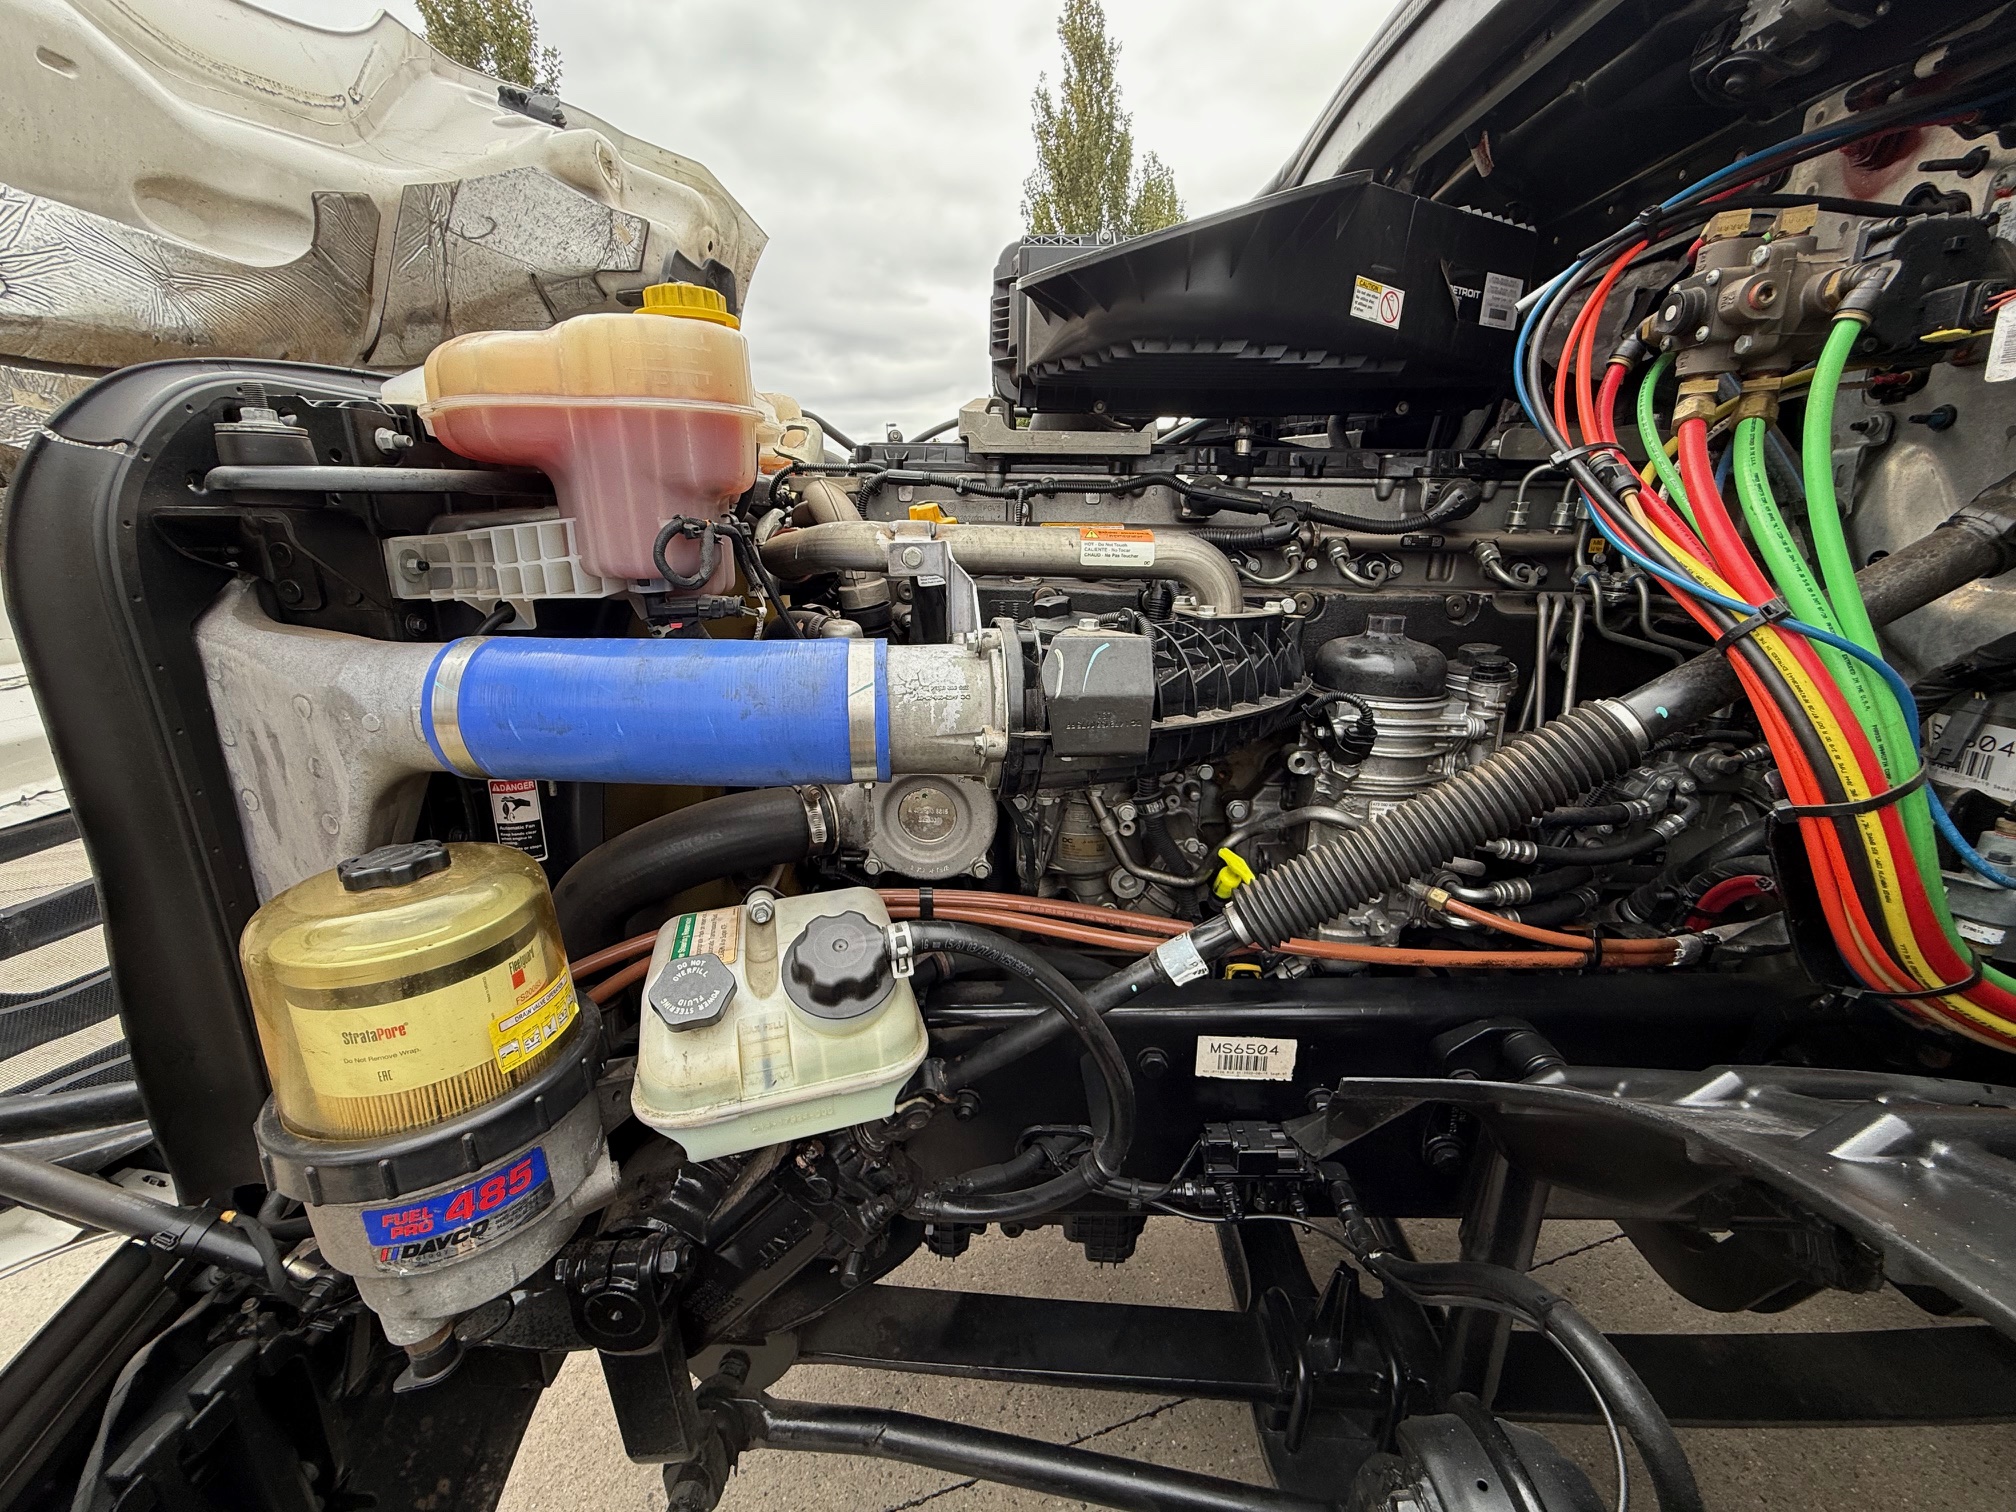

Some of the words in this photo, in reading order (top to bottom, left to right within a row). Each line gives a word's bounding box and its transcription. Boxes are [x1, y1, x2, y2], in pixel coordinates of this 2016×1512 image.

[1359, 278, 1380, 292] CAUTION
[1769, 650, 1789, 673] EXTRUDED
[1839, 651, 1857, 676] EXTRUDED
[500, 781, 535, 792] DANGER
[921, 939, 929, 950] 16
[966, 942, 1000, 961] 03/27/20
[672, 966, 709, 982] OVERFILL
[676, 961, 688, 971] DO
[660, 998, 695, 1015] STEERING
[677, 995, 705, 1006] FLUID
[698, 989, 721, 1011] POWER
[514, 1007, 532, 1023] DRAIN
[531, 998, 547, 1012] VALVE
[341, 1024, 407, 1046] StrataPore
[367, 1053, 398, 1062] Remove
[1210, 1042, 1279, 1056] MS6504
[377, 1069, 393, 1082] EAC
[382, 1206, 434, 1228] FUEL
[444, 1156, 533, 1222] 485
[390, 1218, 434, 1240] PRO
[401, 1218, 490, 1259] DAVCO
